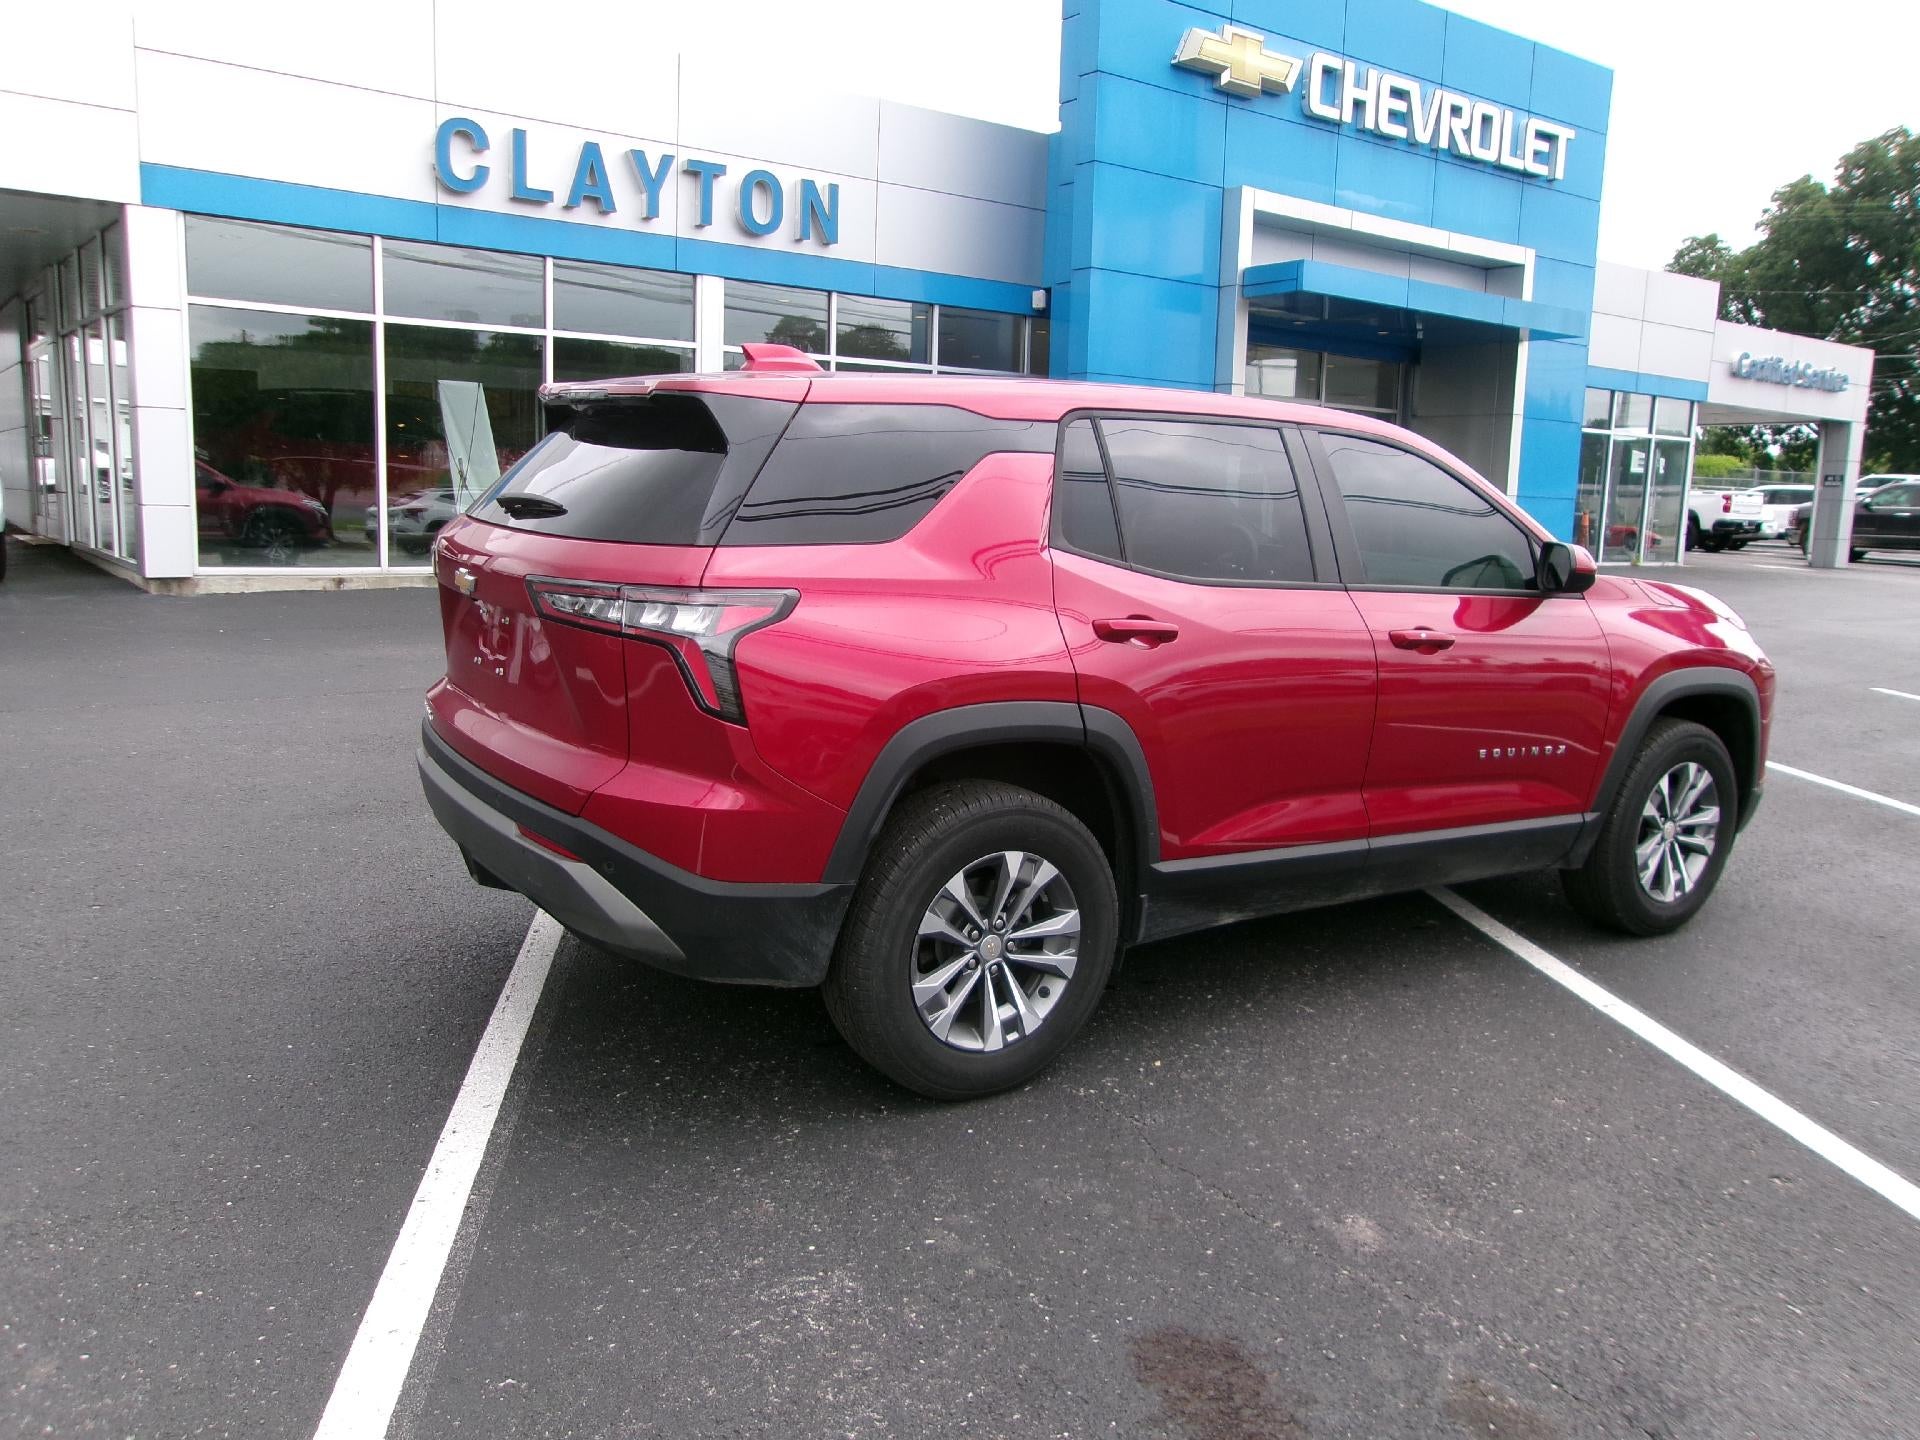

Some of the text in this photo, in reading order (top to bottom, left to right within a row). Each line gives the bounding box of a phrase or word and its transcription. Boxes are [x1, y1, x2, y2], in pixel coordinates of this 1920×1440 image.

[1303, 51, 1575, 181] CHEVROLET
[434, 117, 839, 245] CLAYTON
[1479, 745, 1566, 758] EQUINOX
